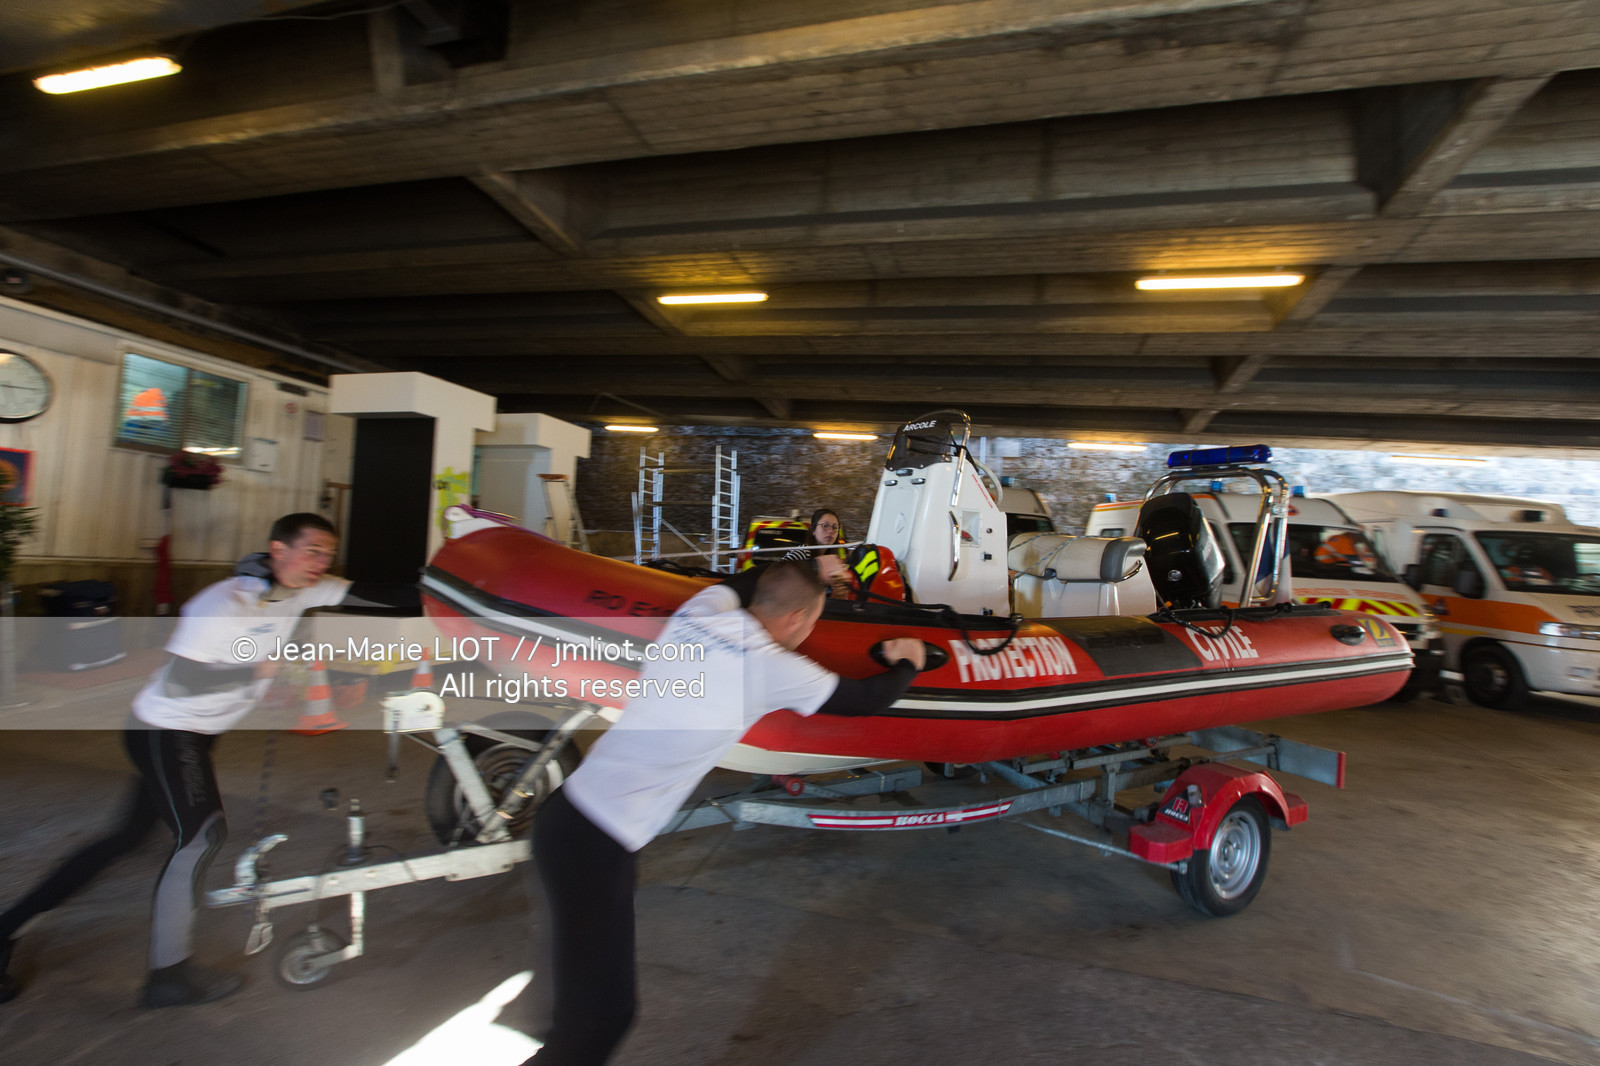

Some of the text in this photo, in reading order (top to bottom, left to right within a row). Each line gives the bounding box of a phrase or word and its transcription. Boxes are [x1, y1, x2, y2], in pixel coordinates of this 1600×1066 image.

[902, 420, 937, 432] ARCOLE
[948, 636, 1078, 683] PROTECTION
[1185, 625, 1259, 661] CIVILE
